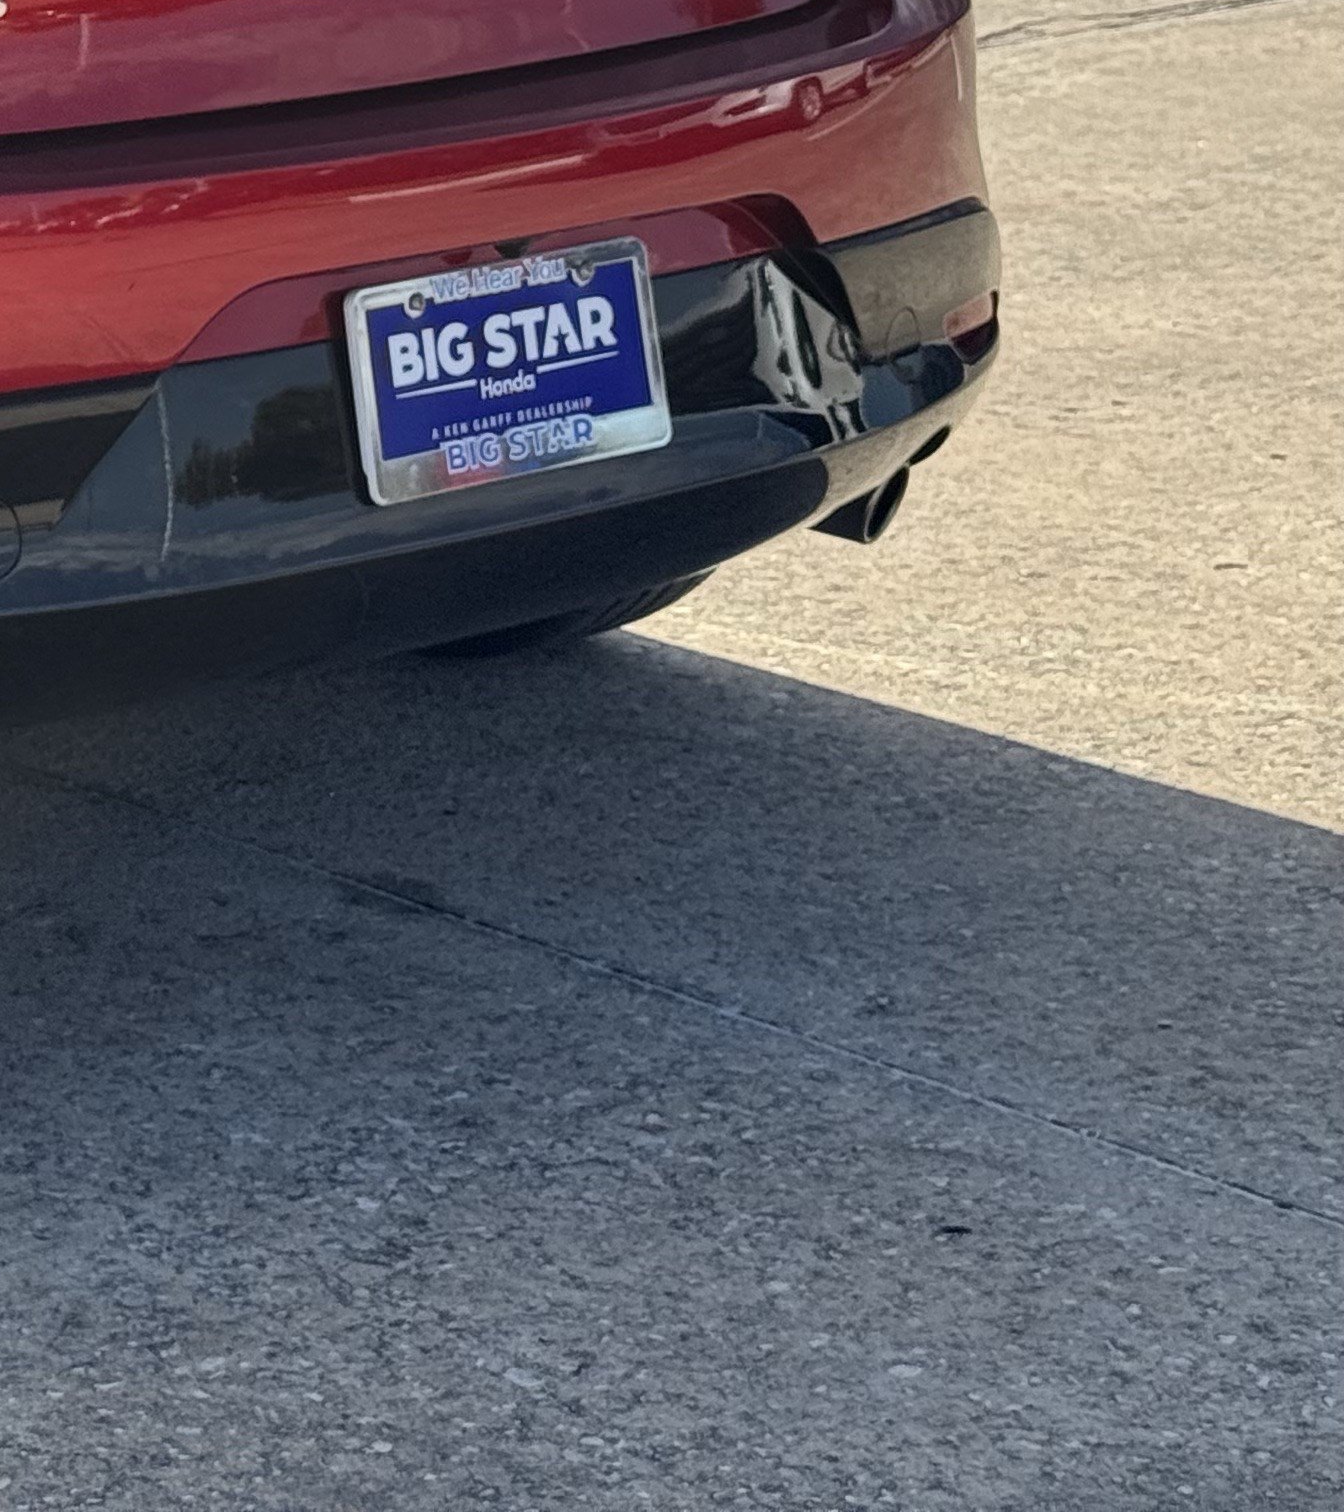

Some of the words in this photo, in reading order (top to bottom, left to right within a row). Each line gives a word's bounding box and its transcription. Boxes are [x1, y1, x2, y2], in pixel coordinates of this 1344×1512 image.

[430, 272, 468, 300] We
[472, 265, 520, 293] Hear
[388, 322, 475, 388] BIG
[483, 296, 617, 368] STAR
[480, 373, 537, 400] Honda
[517, 396, 593, 423] DEALERSHIP
[447, 434, 500, 471] BIG
[506, 415, 594, 458] STAR
